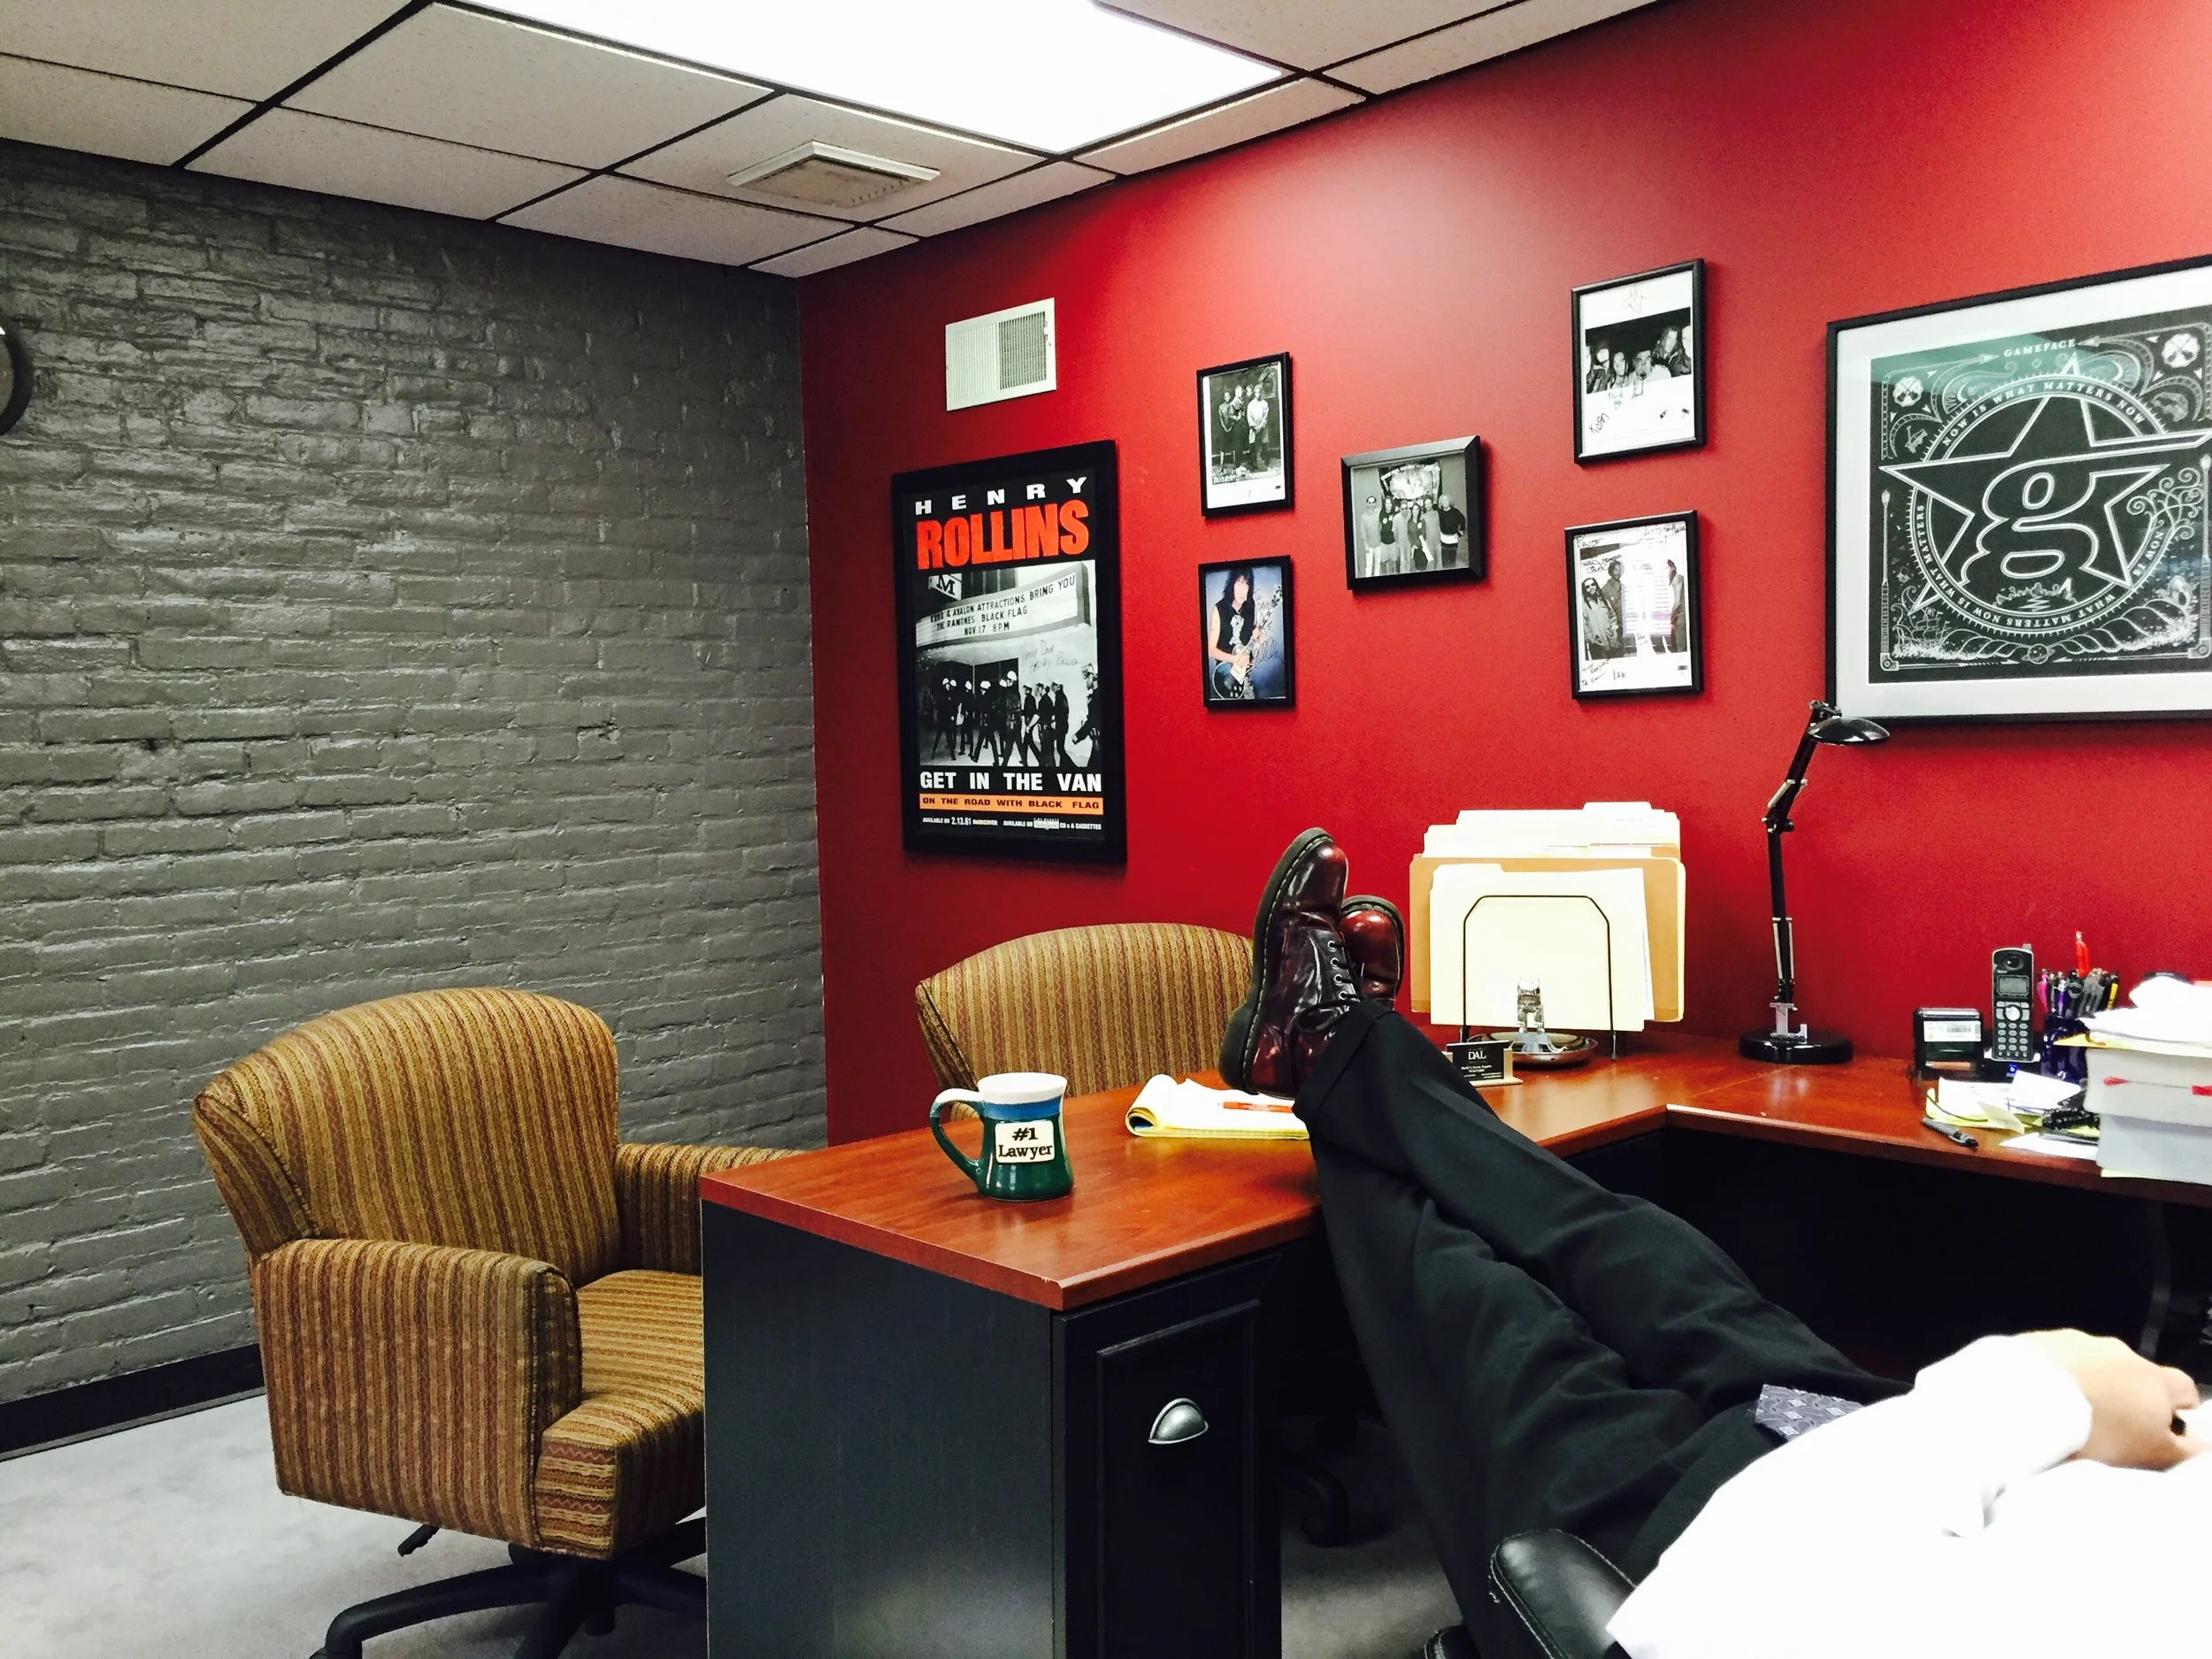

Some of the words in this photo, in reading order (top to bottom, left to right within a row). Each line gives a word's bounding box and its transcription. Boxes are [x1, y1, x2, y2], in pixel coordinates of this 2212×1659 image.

[2003, 339, 2076, 357] GAMEFACE
[1993, 384, 2035, 404] WHAT
[2044, 381, 2114, 402] MATTERS
[1971, 403, 1987, 418] IS
[2116, 399, 2145, 424] NOW
[1941, 418, 1968, 447] NOW
[915, 476, 1087, 515] HENRY
[917, 499, 1089, 570] ROLLINS
[1916, 505, 1933, 565] MATTERS
[2145, 531, 2165, 560] NOW
[2132, 563, 2147, 577] IS
[1930, 568, 1955, 598] WHAT
[952, 604, 974, 616] AVALON
[977, 595, 1025, 612] ATTRACTIONS
[1029, 584, 1054, 601] BRING
[1057, 574, 1076, 590] YOU
[1957, 597, 1970, 609] IS
[947, 616, 975, 627] RAMONES
[981, 611, 1004, 623] BLACK
[1007, 605, 1028, 618] FLAG
[1972, 606, 2001, 624] NOW
[2078, 594, 2116, 618] WHAT
[964, 626, 976, 636] NOV
[978, 625, 986, 634] 17
[2006, 614, 2072, 627] MATTERS
[920, 772, 956, 789] GET
[970, 772, 989, 789] IN
[1002, 772, 1043, 791] THE
[1056, 773, 1102, 792] VAN
[1468, 1050, 1486, 1060] DAL
[1012, 1127, 1038, 1141] #1
[998, 1144, 1053, 1159] Lawyer
